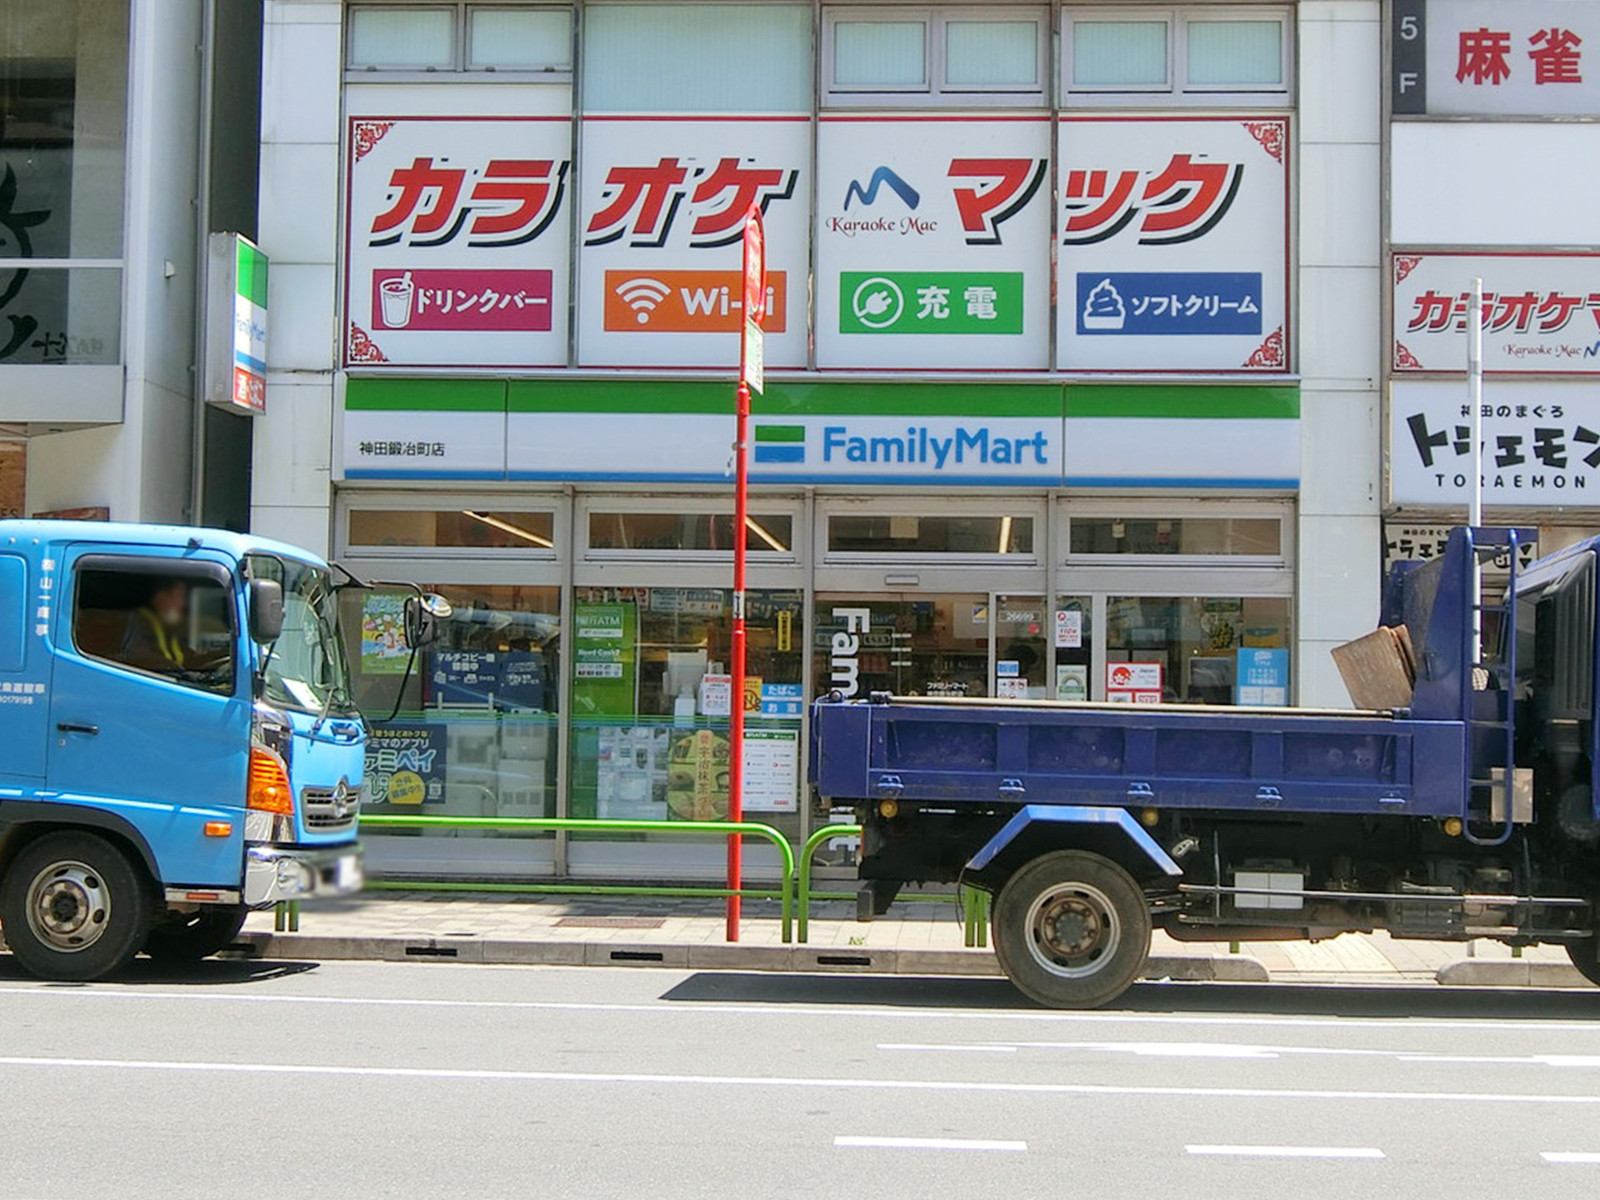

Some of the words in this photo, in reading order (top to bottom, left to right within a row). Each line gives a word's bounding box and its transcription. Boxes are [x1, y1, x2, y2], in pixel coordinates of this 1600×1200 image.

[1455, 27, 1583, 85] 麻雀
[825, 216, 896, 237] Karaoke
[900, 217, 938, 235] Mac
[416, 287, 548, 314] ドリンクバー
[680, 286, 774, 317] Wi-i
[916, 286, 998, 319] 充電
[1130, 294, 1259, 316] ソフトクリーム
[1406, 290, 1600, 334] カラオケ
[359, 441, 446, 457] 神田鍛冶町店
[824, 427, 1048, 470] FamilyMart
[1435, 473, 1586, 488] TOAEMON
[768, 685, 797, 696] たばこ
